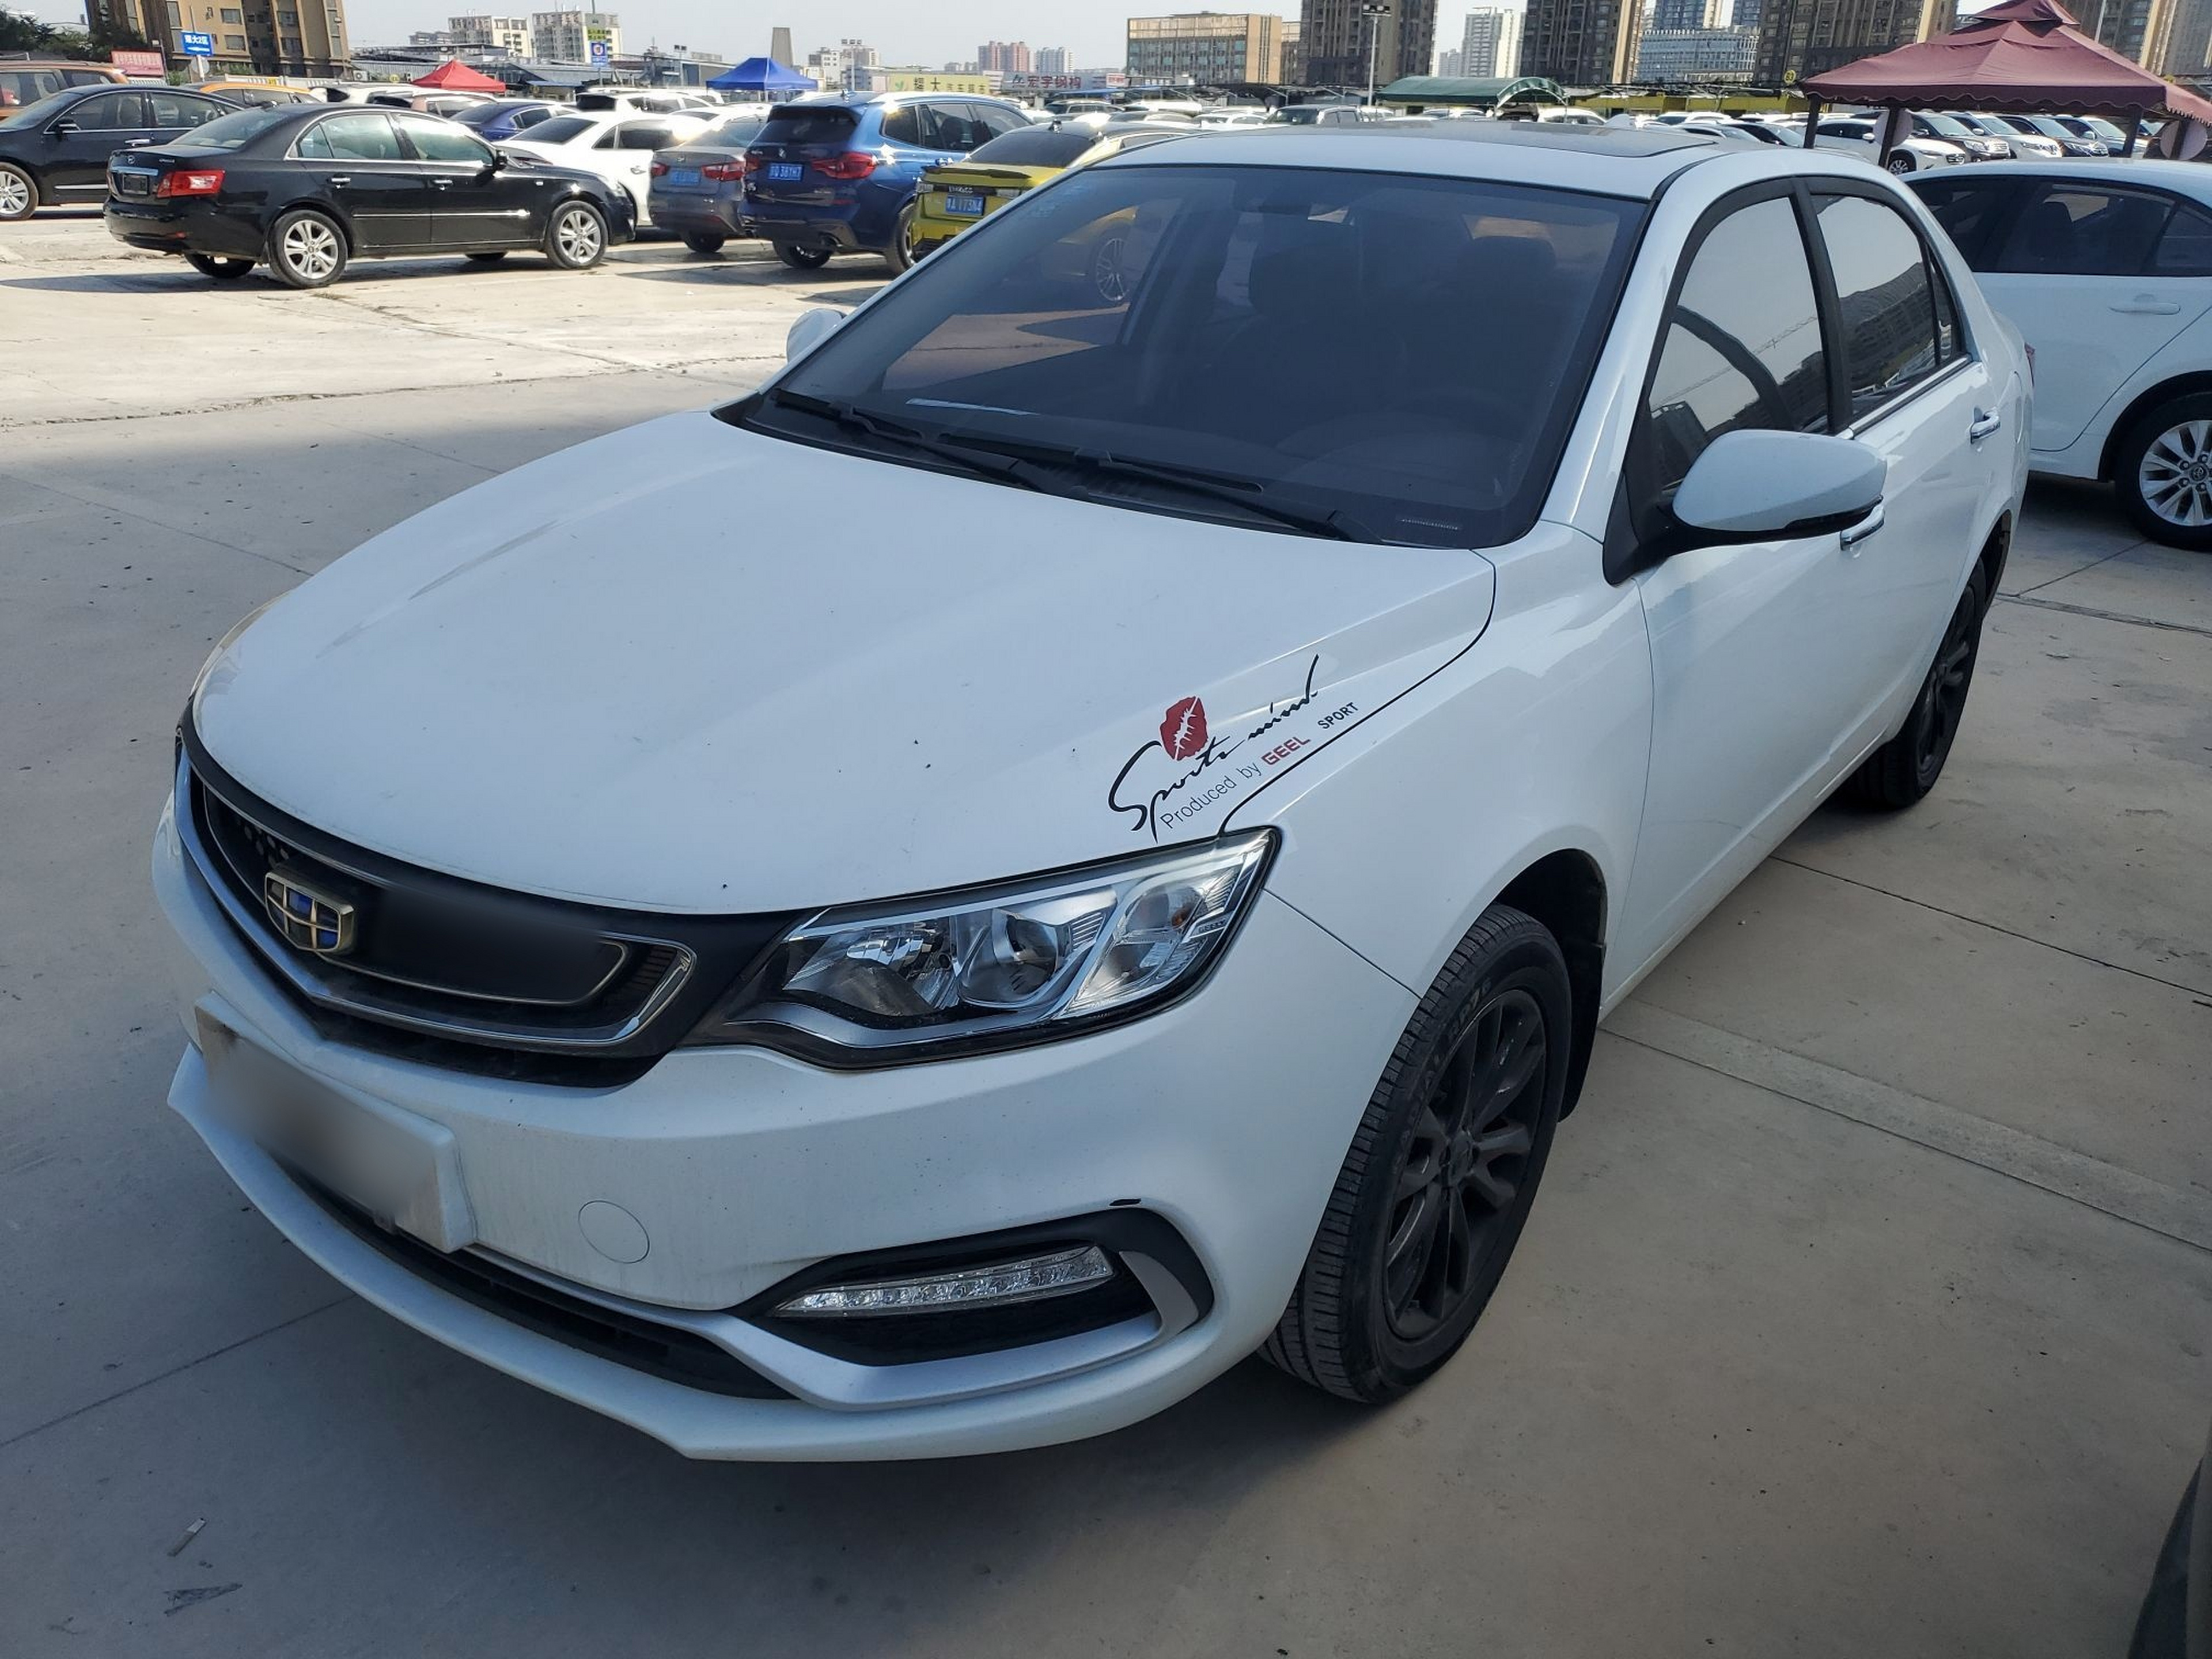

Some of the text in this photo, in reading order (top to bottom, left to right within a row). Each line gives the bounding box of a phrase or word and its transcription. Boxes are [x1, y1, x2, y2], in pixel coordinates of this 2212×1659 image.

[1160, 702, 1359, 829] Produced by GEEL SPORT
